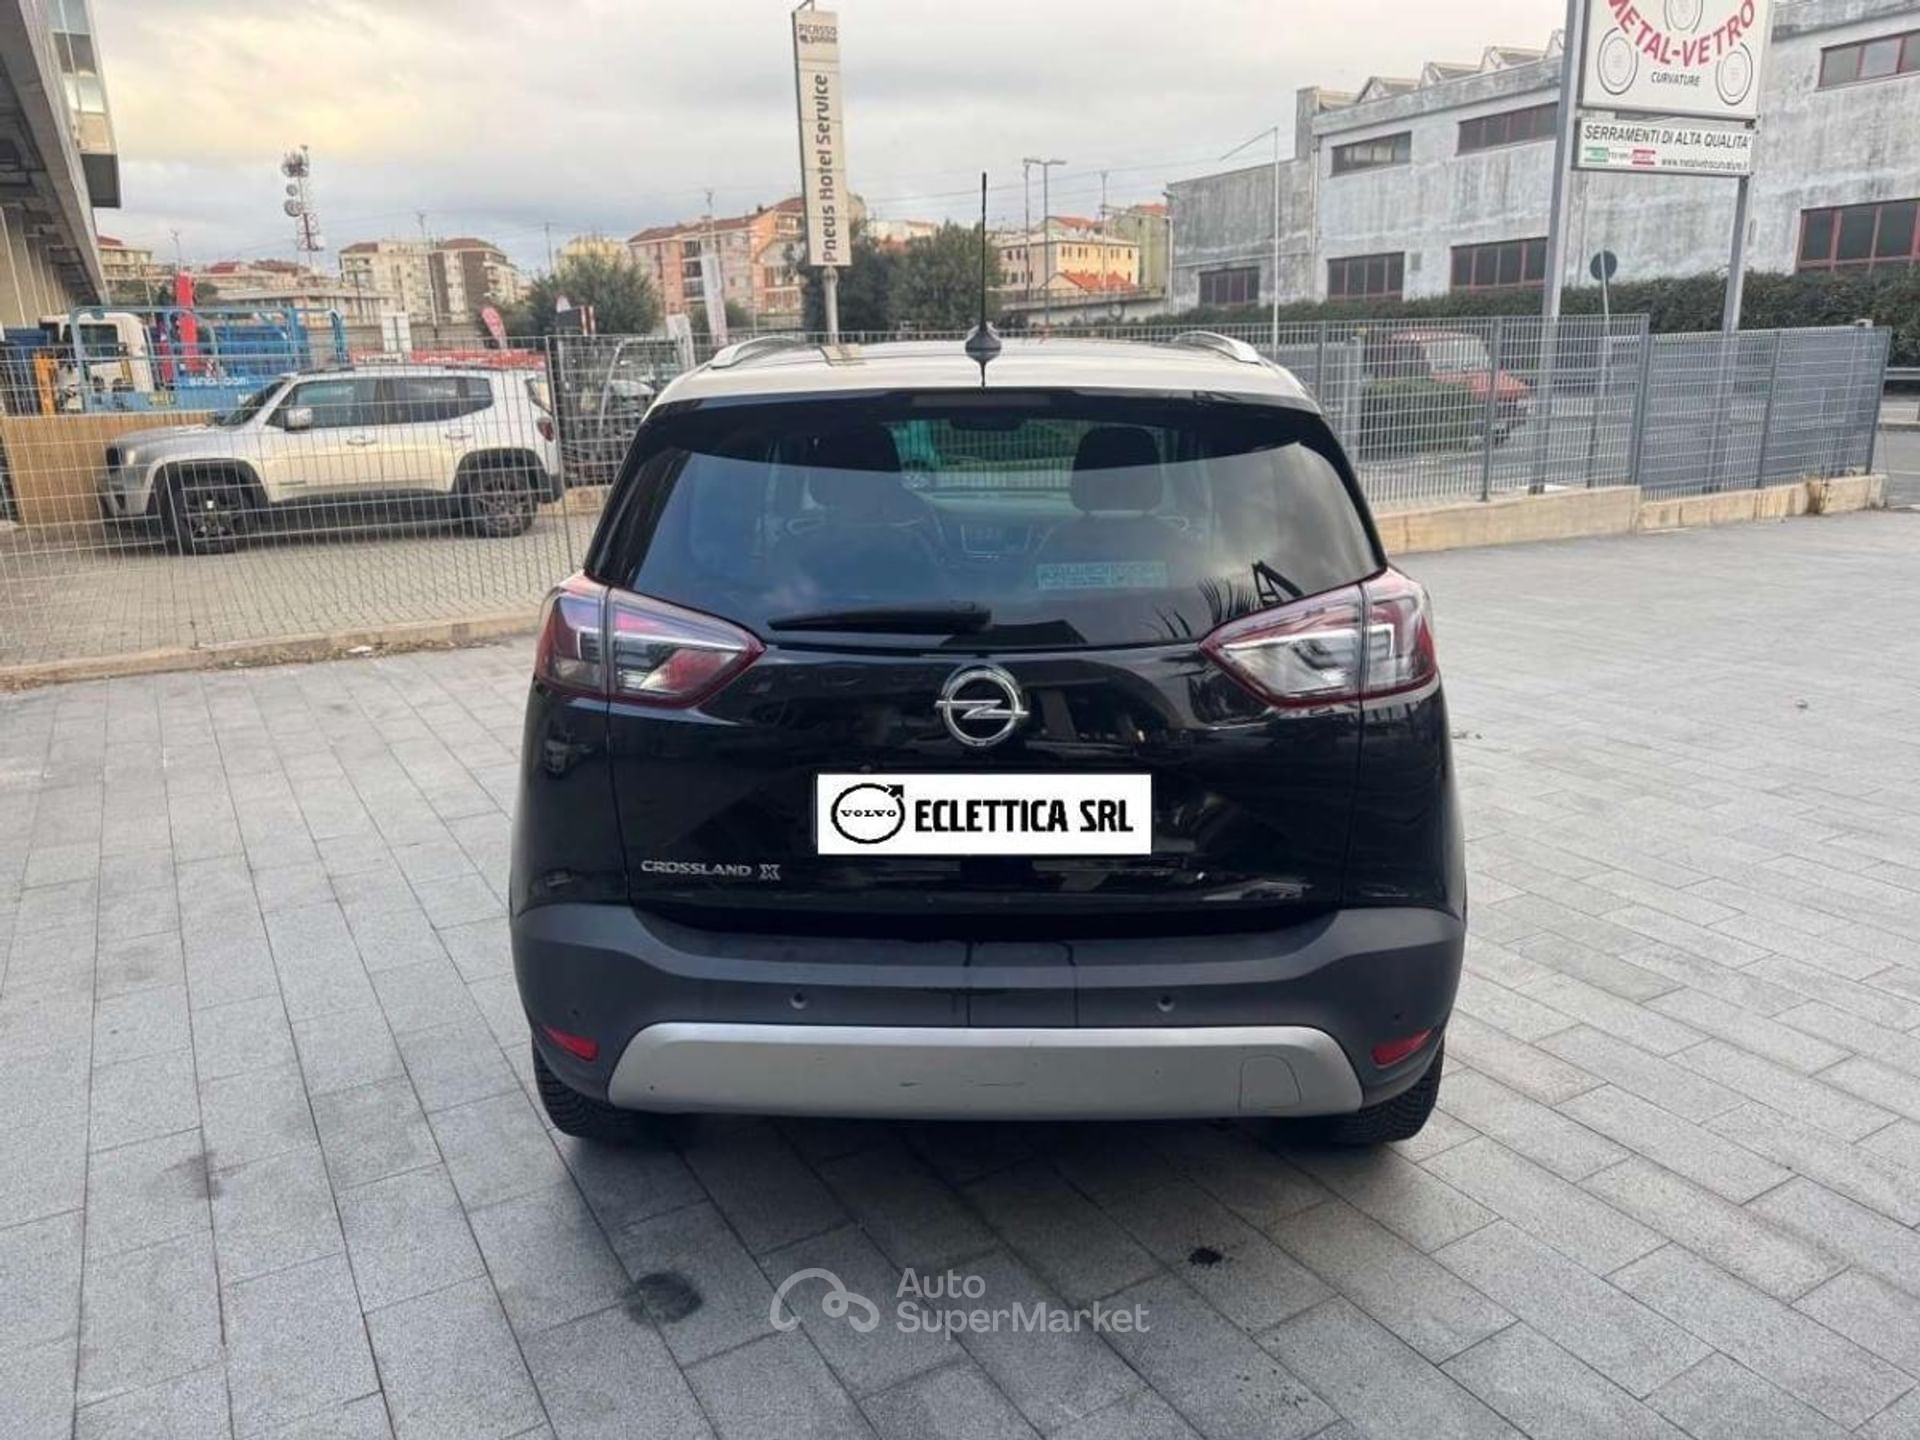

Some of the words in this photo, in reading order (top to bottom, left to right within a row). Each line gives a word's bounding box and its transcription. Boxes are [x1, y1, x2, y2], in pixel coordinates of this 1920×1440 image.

[1651, 71, 1701, 86] CURVATURE
[814, 74, 831, 145] Service
[1584, 125, 1661, 143] SERRAMENTI
[1662, 130, 1674, 144] DI
[1675, 131, 1702, 146] ALTA
[819, 151, 833, 200] Hotel
[823, 207, 838, 263] Pneus
[640, 860, 753, 877] CROSSLAND
[758, 863, 782, 881] X
